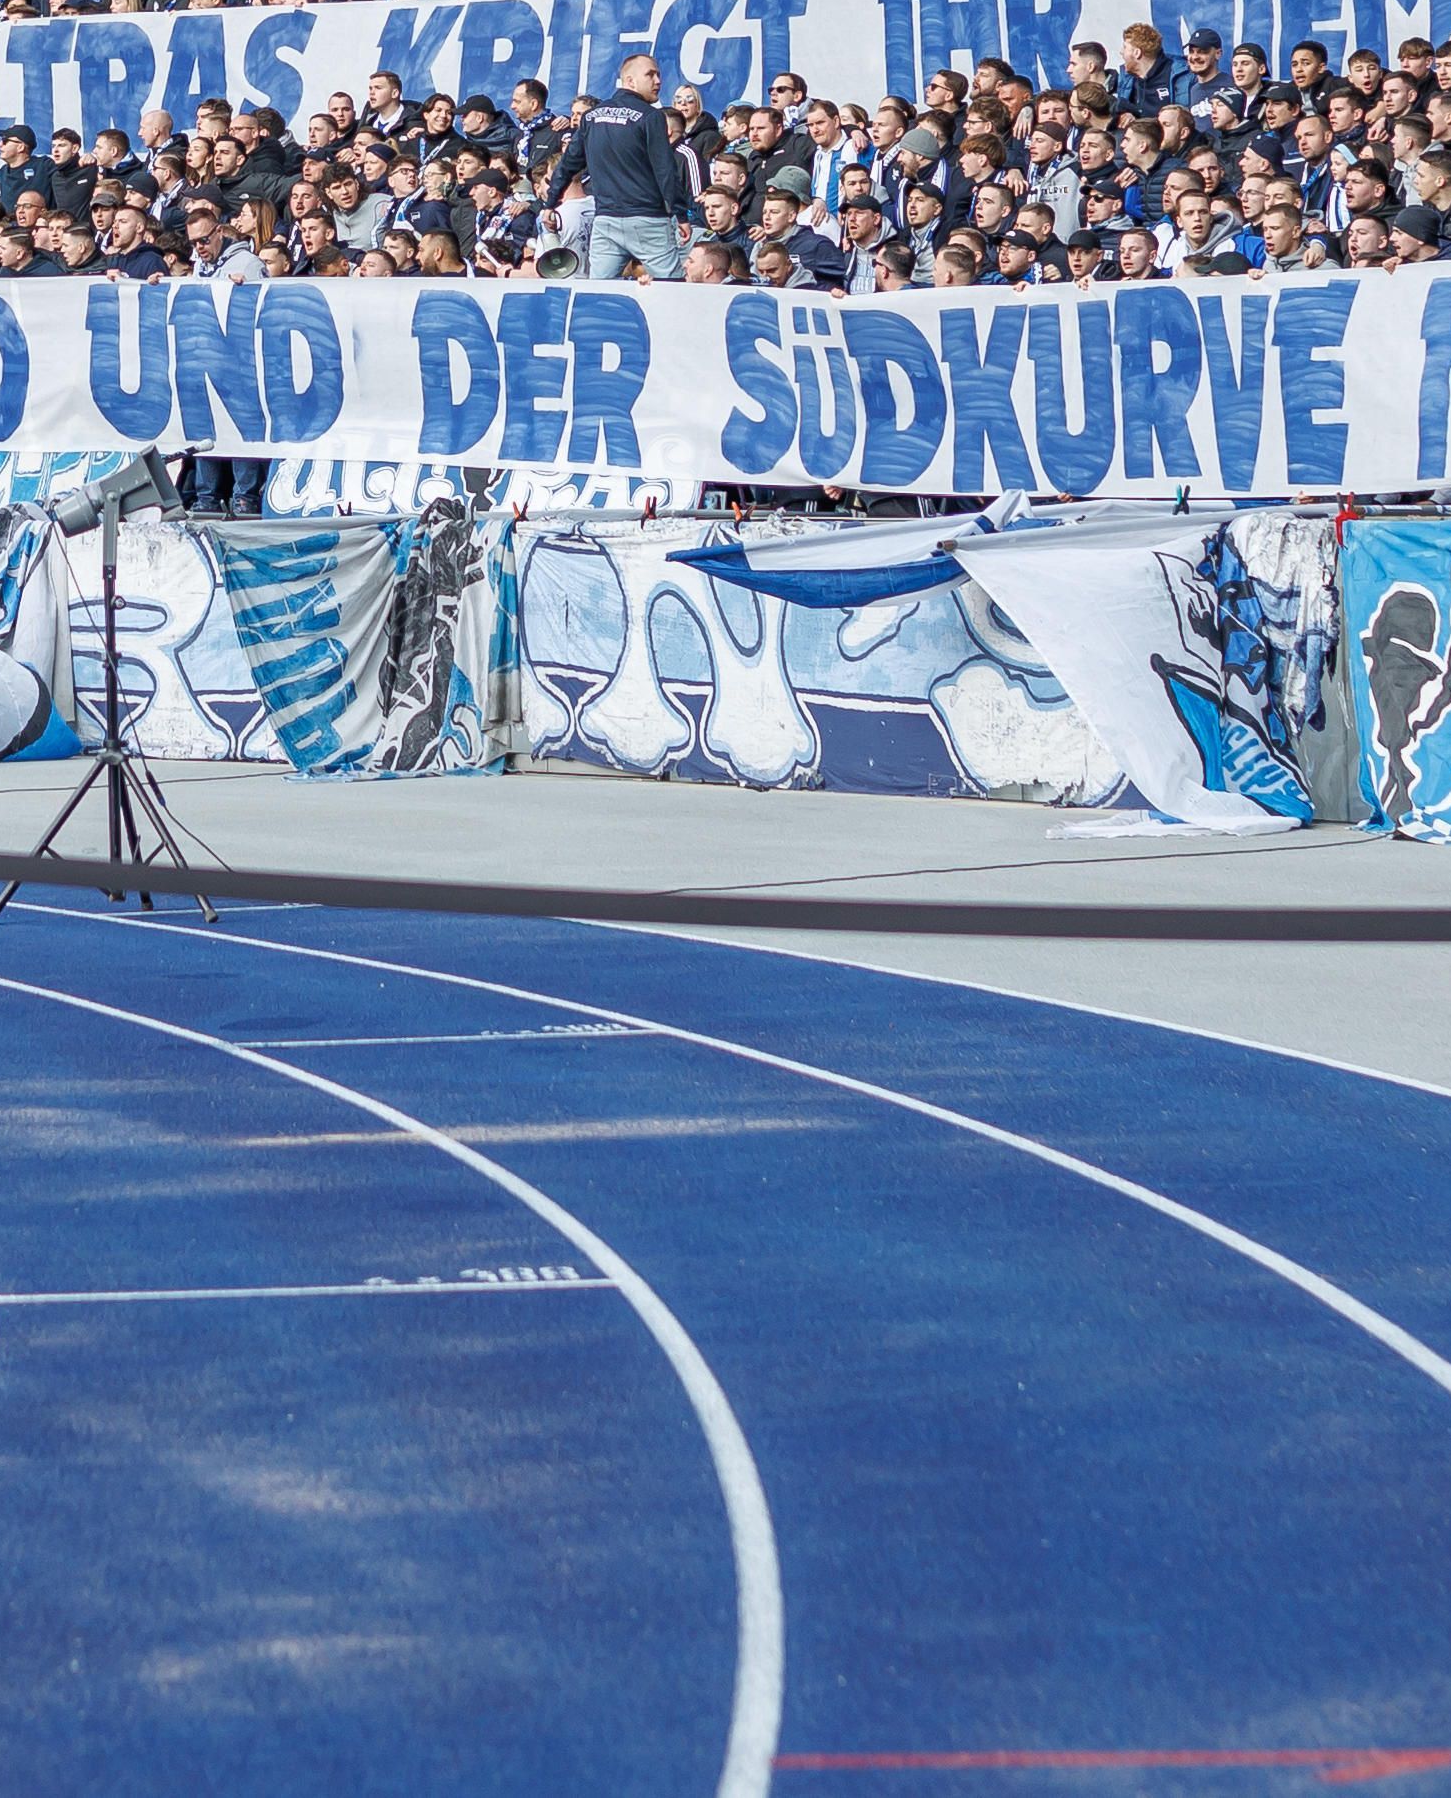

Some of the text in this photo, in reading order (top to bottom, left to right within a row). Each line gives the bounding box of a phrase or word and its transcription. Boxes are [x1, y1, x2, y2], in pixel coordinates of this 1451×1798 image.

[84, 282, 345, 445] UND
[411, 285, 652, 470] DER
[720, 279, 1360, 499] SÜDKURVE
